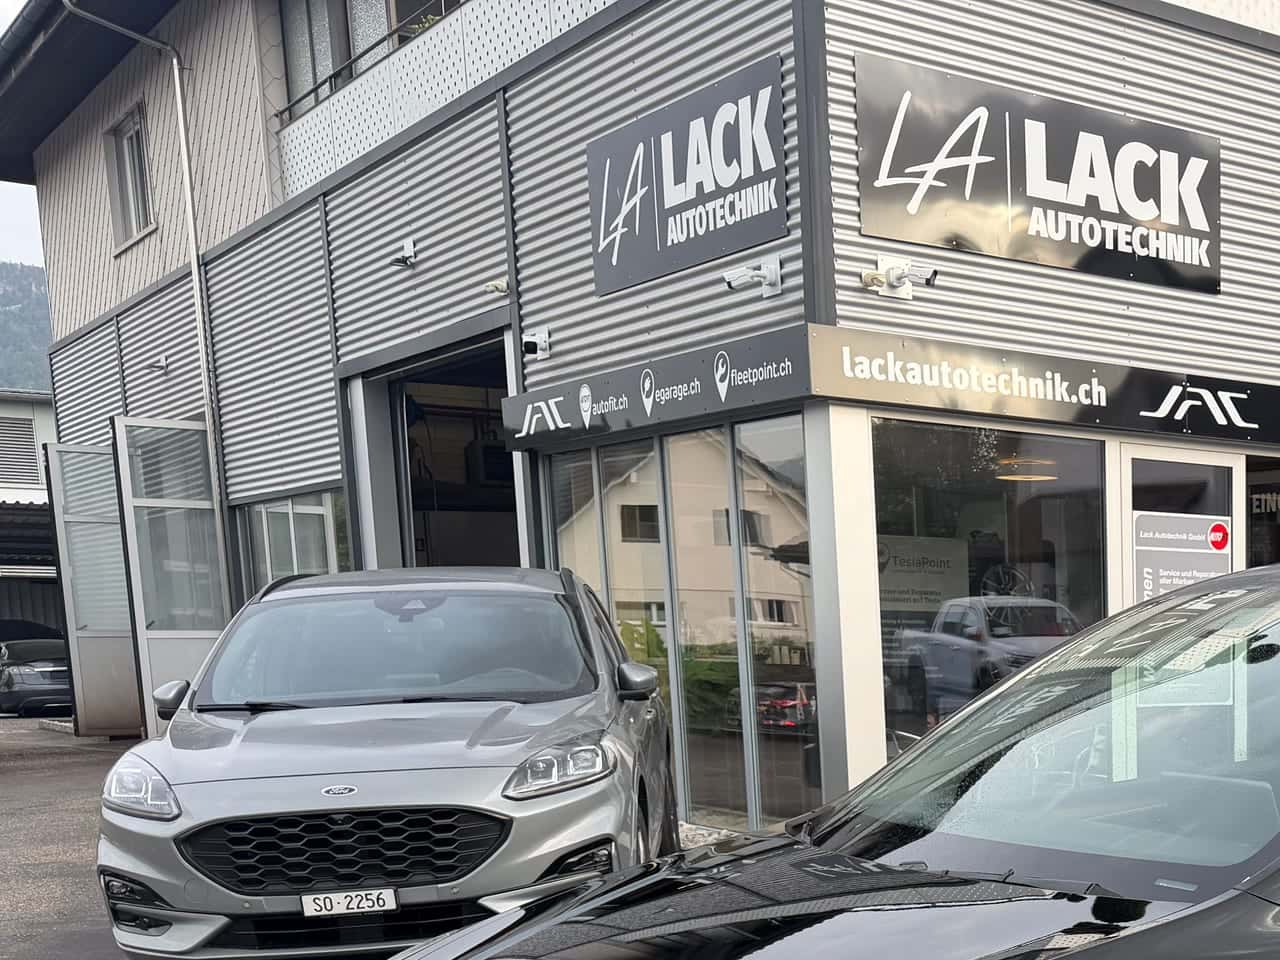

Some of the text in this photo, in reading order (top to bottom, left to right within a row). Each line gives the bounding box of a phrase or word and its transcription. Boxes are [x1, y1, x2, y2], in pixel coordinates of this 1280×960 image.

[661, 84, 778, 210] LACK
[873, 90, 997, 214] LA
[1024, 118, 1210, 233] LACK
[597, 141, 649, 267] LA
[667, 177, 778, 248] AUTOTECHNIK
[1028, 207, 1211, 269] AUTOTECHNIK
[654, 377, 701, 404] egarage.ch
[729, 357, 793, 387] fleetpoint.ch
[841, 346, 1108, 407] lackautotechnik.ch
[591, 394, 629, 416] autofit.ch
[891, 555, 952, 569] TeslaPoint
